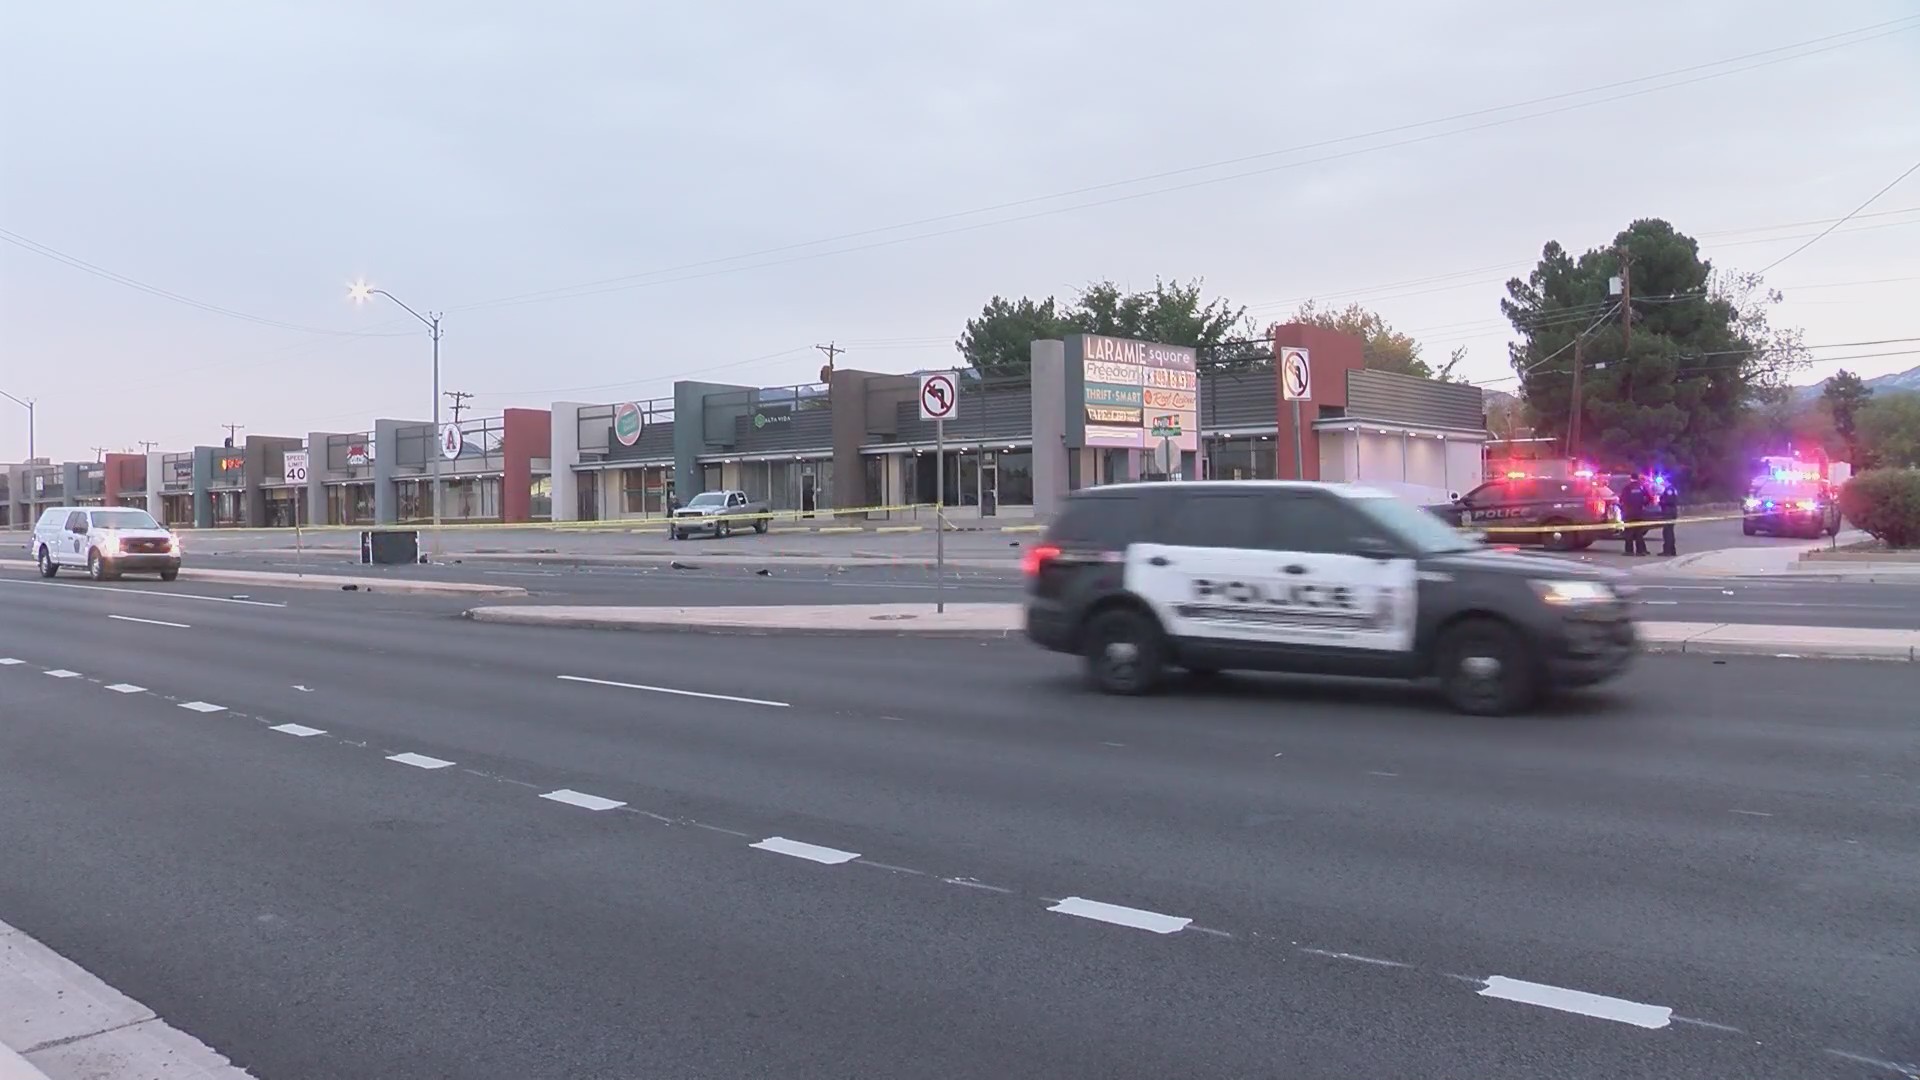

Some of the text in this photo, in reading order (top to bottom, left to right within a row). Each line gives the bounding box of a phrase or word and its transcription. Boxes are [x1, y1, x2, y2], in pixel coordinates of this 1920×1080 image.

[1087, 336, 1190, 366] LARAMIE square
[1086, 362, 1138, 379] Freedom
[286, 467, 306, 480] 40
[1474, 507, 1531, 519] POLICE
[1191, 577, 1355, 609] POLICE
